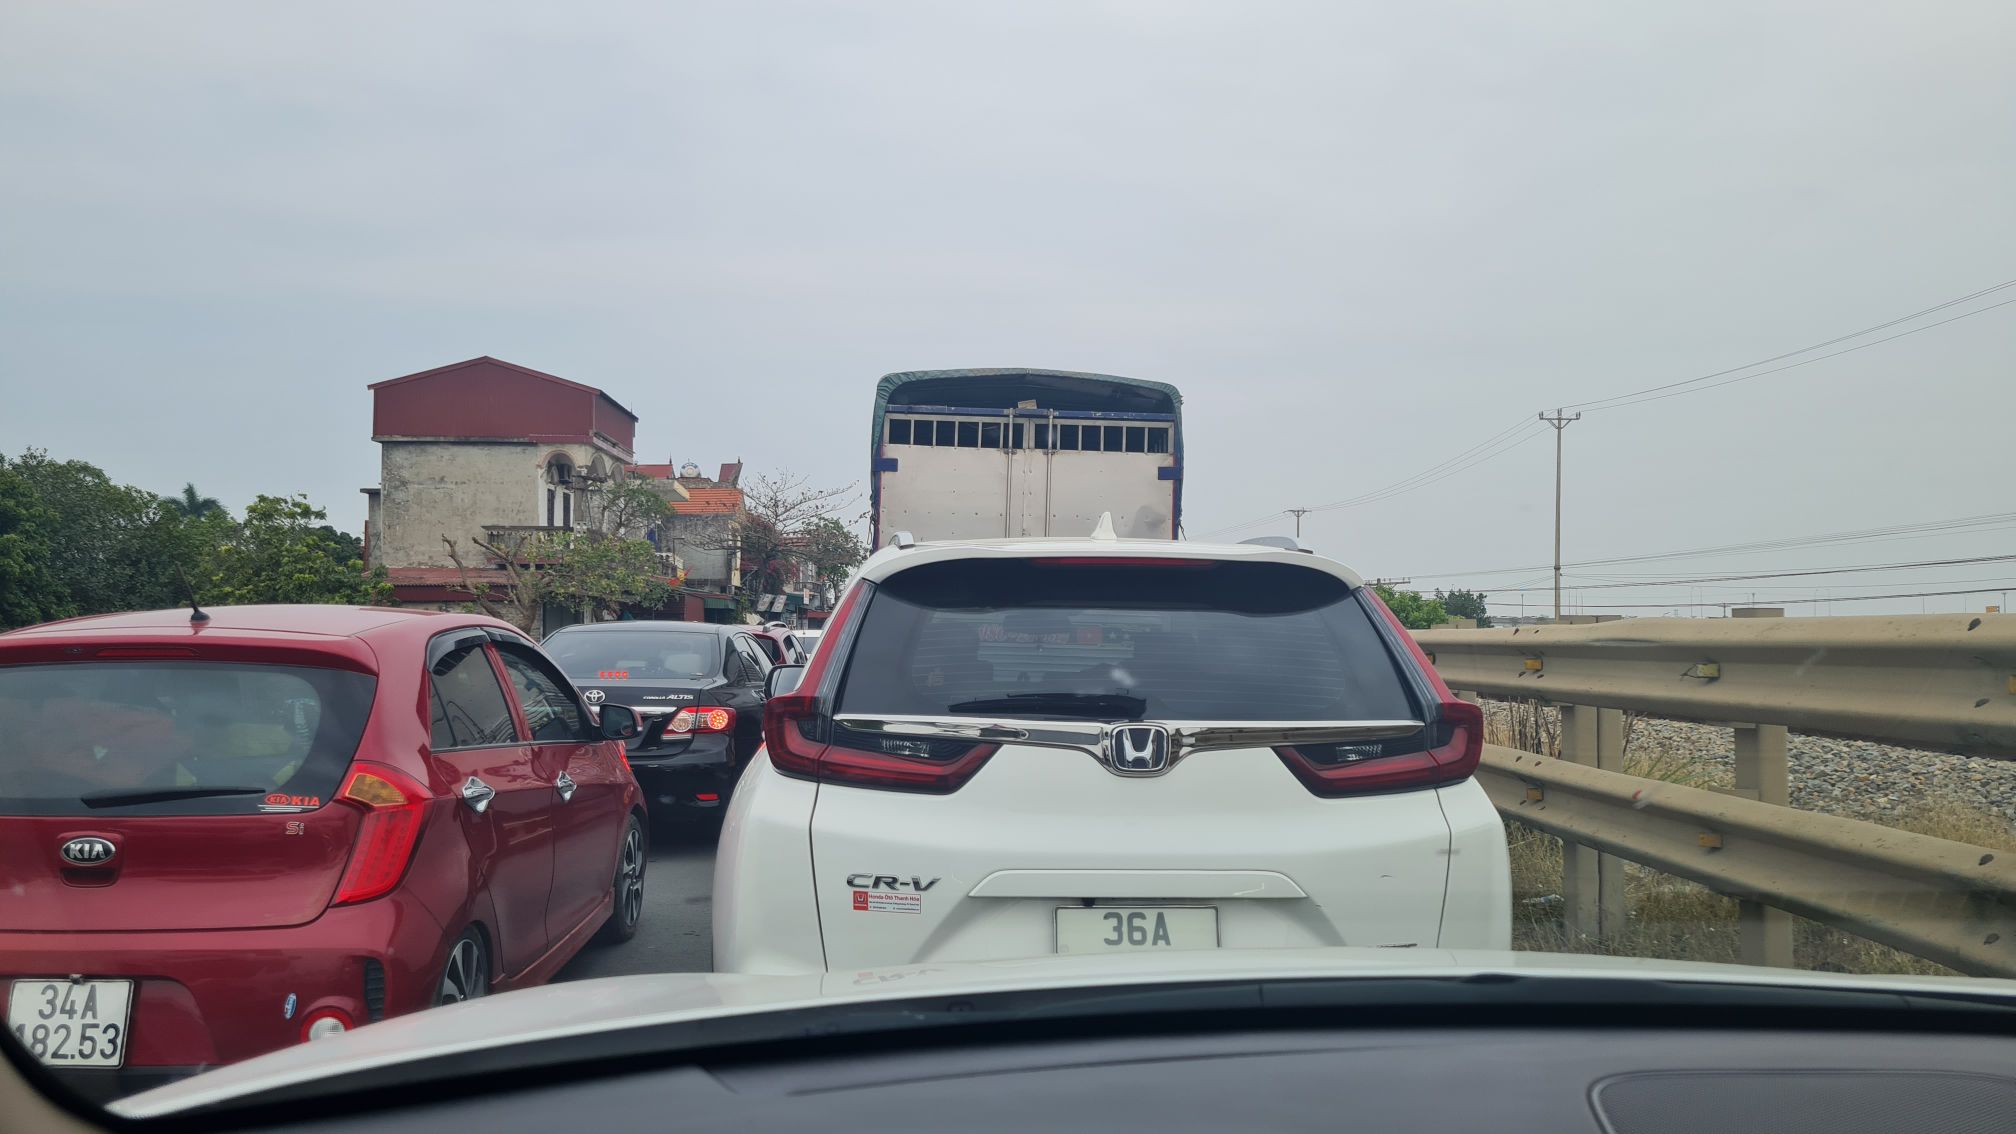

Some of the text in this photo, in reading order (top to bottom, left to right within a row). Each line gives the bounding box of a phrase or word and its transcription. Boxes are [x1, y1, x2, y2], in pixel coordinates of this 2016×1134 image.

[270, 796, 320, 806] KIA KIA
[69, 843, 106, 859] KIA
[846, 873, 942, 891] CR-V
[1103, 911, 1172, 946] 36A
[38, 984, 98, 1020] 34A
